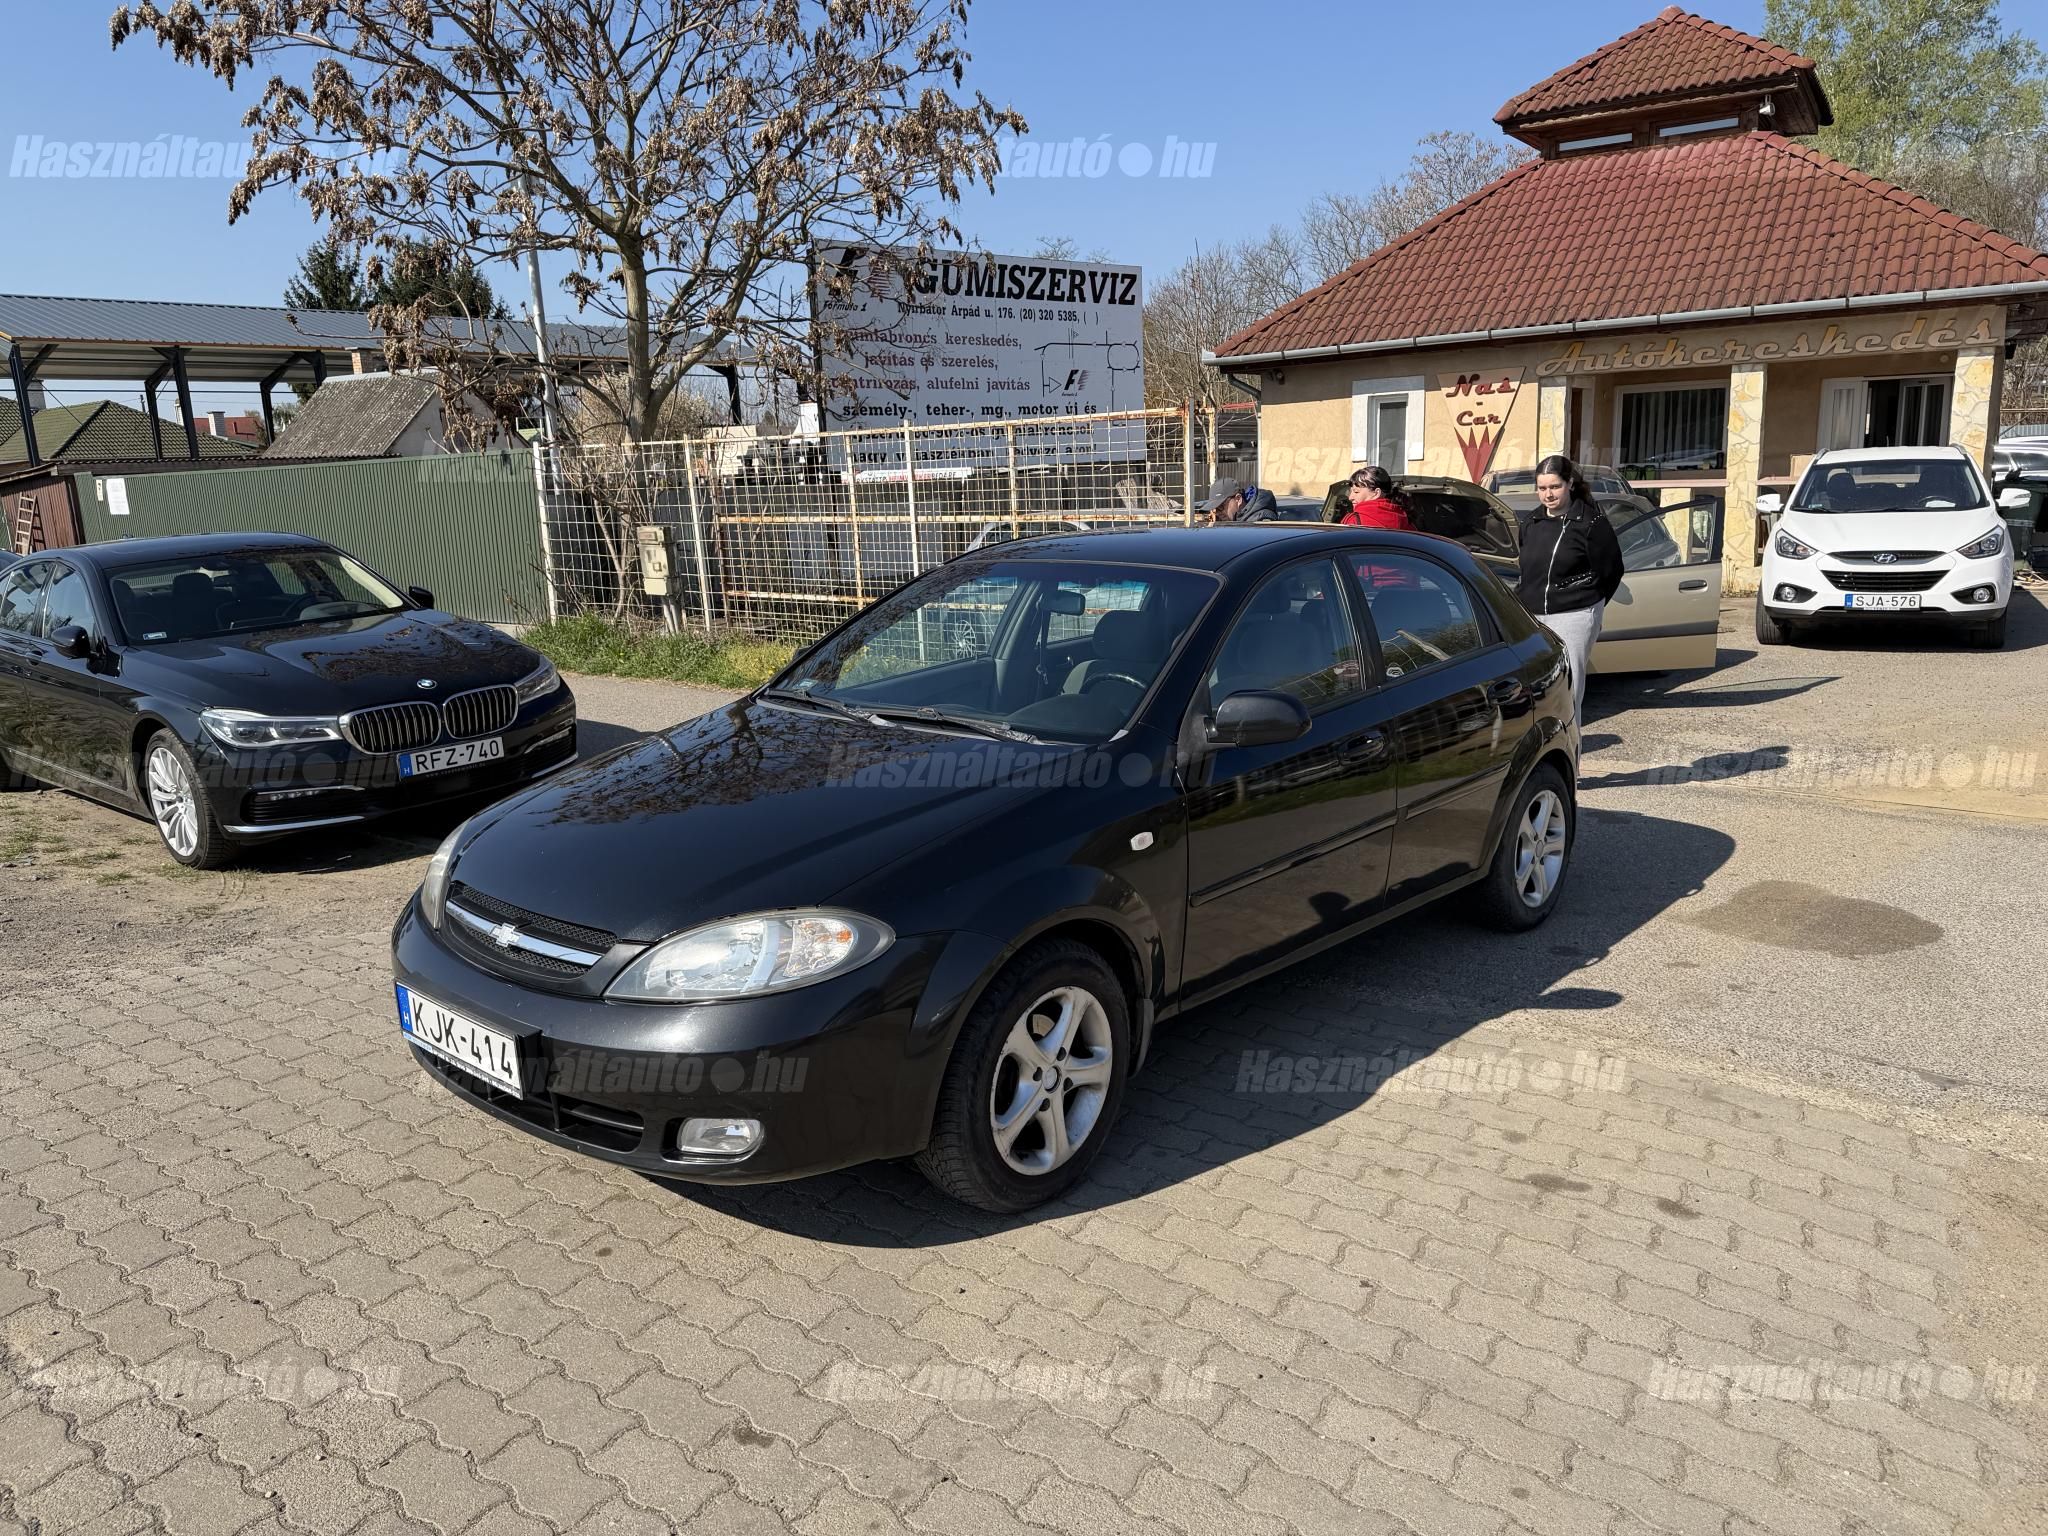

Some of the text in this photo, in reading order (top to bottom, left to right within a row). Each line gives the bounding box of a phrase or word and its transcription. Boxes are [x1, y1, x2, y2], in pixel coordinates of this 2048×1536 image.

[914, 259, 1138, 306] GUMISZERVIZ
[951, 300, 981, 319] Árpád
[984, 308, 994, 318] u.
[998, 307, 1015, 319] 176.
[1020, 307, 1036, 322] (20)
[1038, 309, 1054, 321] 320
[1057, 310, 1080, 323] 5385,
[946, 332, 1022, 349] kereskedés,
[1535, 317, 1999, 377] Autókereskedés
[865, 352, 998, 371] javítás és szerelés,
[927, 376, 979, 390] alufelni
[986, 377, 1031, 393] javítás
[1445, 373, 1516, 398] Nas
[843, 402, 1097, 419] személy-, teher-, mg., motor új és
[1456, 410, 1502, 426] Car
[1855, 595, 1916, 607] SJA-576
[415, 740, 500, 772] RFZ-740
[412, 997, 513, 1080] KJK-414
